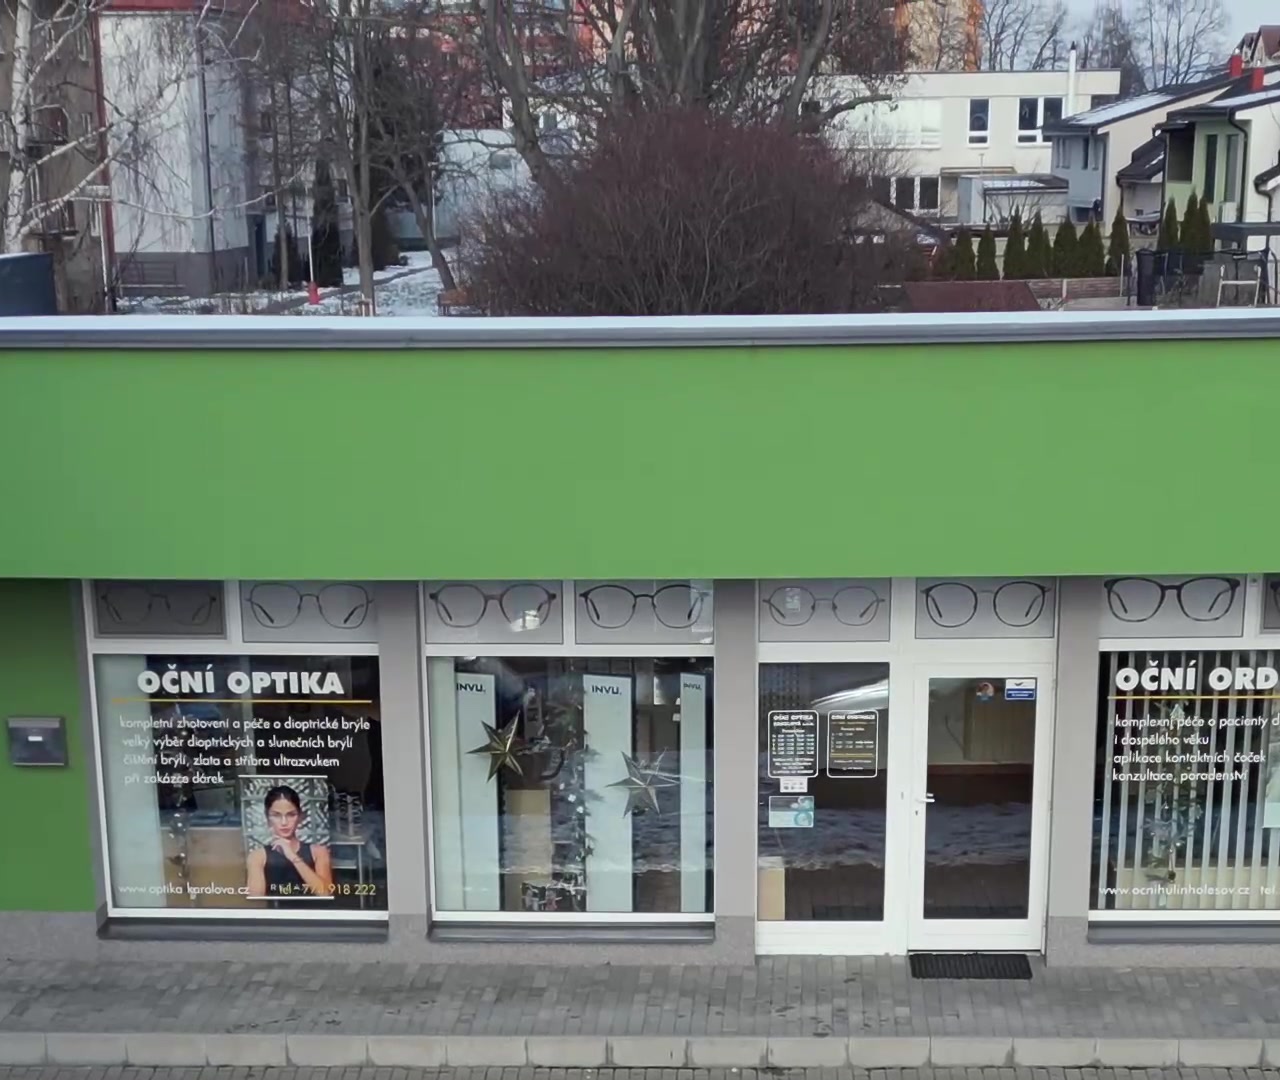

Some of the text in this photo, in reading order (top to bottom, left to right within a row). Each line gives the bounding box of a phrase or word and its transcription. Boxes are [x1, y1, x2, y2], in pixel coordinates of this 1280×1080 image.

[137, 663, 344, 695] OČNÍ OPTIKA
[1115, 660, 1196, 691] OČNÍ
[120, 715, 371, 733] kompletní zhotovení a péče o dioptrické brýle
[1115, 713, 1174, 730] komplexní
[1176, 716, 1205, 731] péče
[1207, 719, 1216, 727] o
[1219, 715, 1268, 730] pacienty
[122, 734, 353, 751] velký výběr dioptrických a slunečních brýlí
[1121, 732, 1180, 748] dospělého
[1183, 732, 1210, 745] věku
[193, 753, 221, 766] zlata
[223, 758, 232, 766] a
[234, 753, 270, 766] stříbra
[273, 753, 340, 767] ultrazvukem
[1113, 749, 1267, 765] aplikace kontaktních čoček
[144, 770, 189, 784] zakázce
[192, 771, 224, 784] dárek
[1112, 767, 1248, 784] konzultace, poradenství
[328, 883, 351, 895] 918
[354, 883, 376, 896] 222
